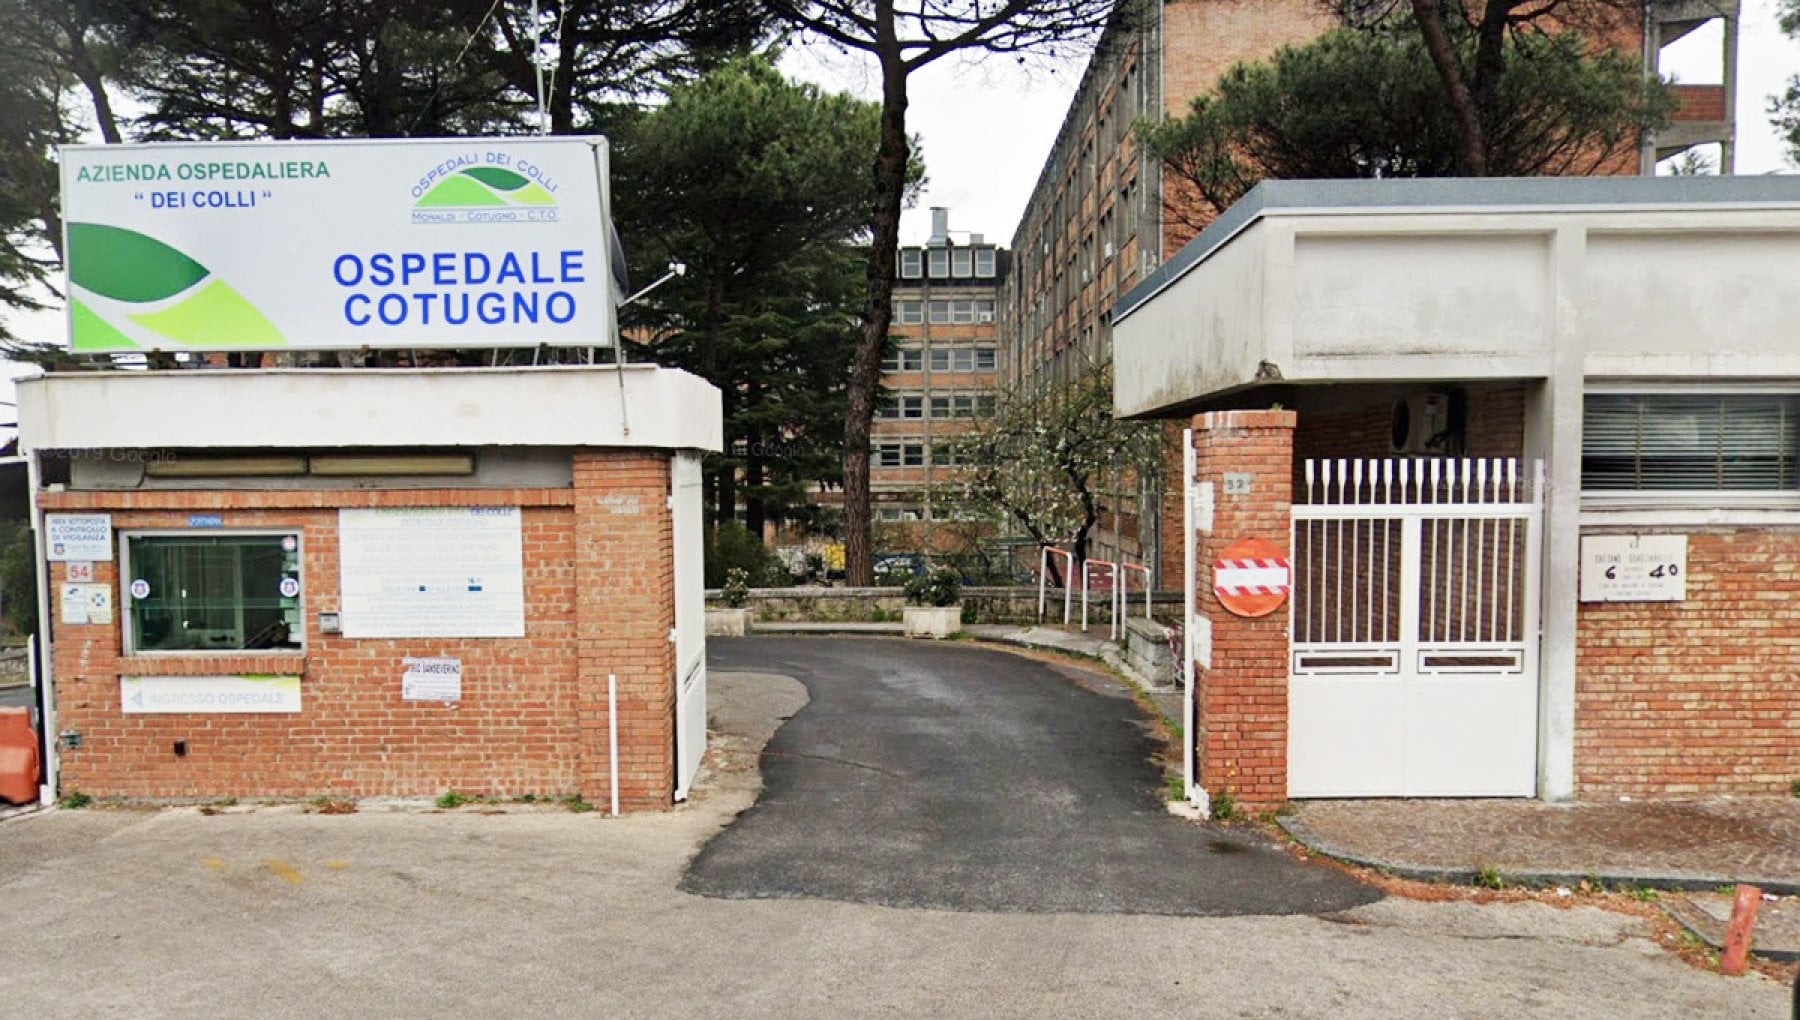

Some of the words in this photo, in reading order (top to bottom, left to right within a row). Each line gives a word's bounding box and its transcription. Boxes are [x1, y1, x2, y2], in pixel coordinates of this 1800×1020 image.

[77, 164, 171, 182] AZIENDA
[177, 161, 330, 181] OSPEDALIERA
[411, 151, 478, 199] OSPEDALI
[485, 151, 511, 165] DEI
[516, 159, 559, 193] COLLI
[151, 191, 186, 208] DEI
[192, 191, 256, 208] COLLI
[333, 250, 586, 287] OSPEDALE
[344, 291, 577, 326] COTUGNO
[70, 564, 88, 578] 54
[1604, 564, 1617, 580] 6
[149, 692, 215, 705] INGRESSO
[218, 691, 285, 704] OSPEDALE
